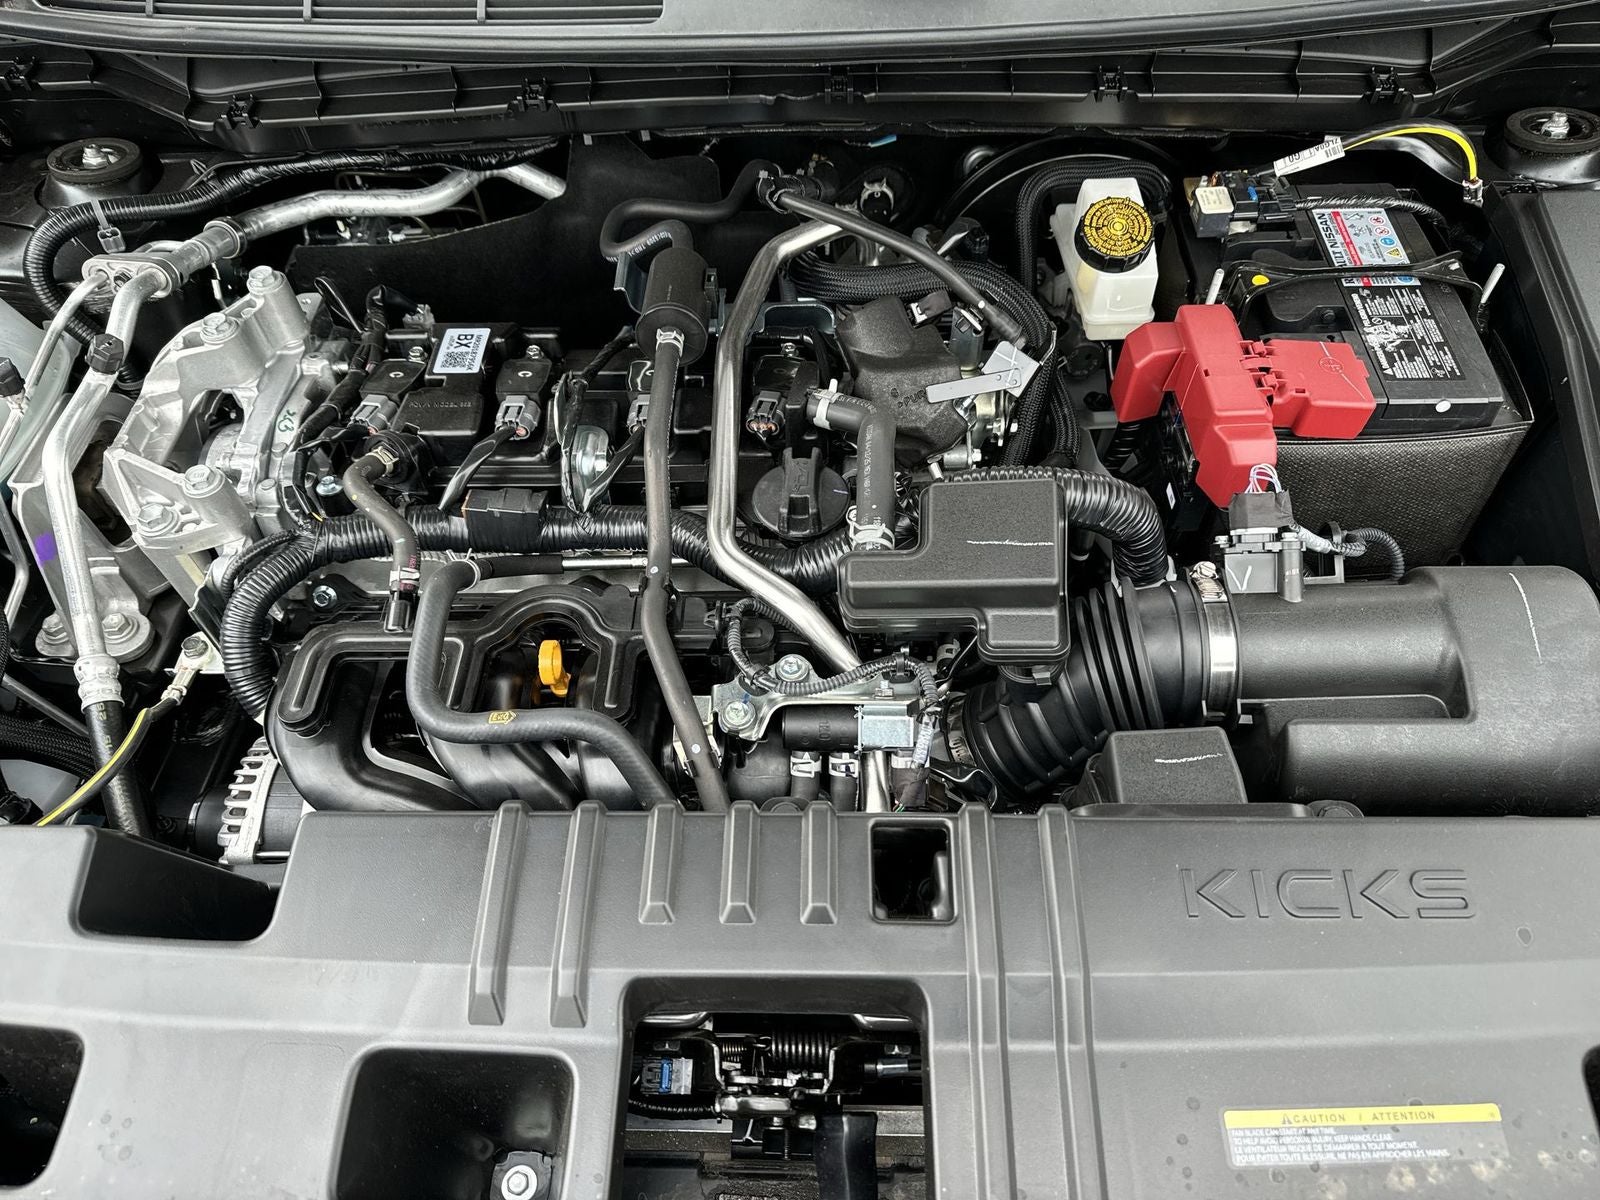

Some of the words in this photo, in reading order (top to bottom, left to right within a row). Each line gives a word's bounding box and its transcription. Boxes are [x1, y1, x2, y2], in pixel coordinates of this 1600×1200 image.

[1319, 212, 1341, 254] NISSAN
[454, 334, 474, 349] BX
[1180, 868, 1475, 918] KICKS
[1293, 1114, 1345, 1123] CAUTION
[1372, 1111, 1435, 1121] ATTENTION
